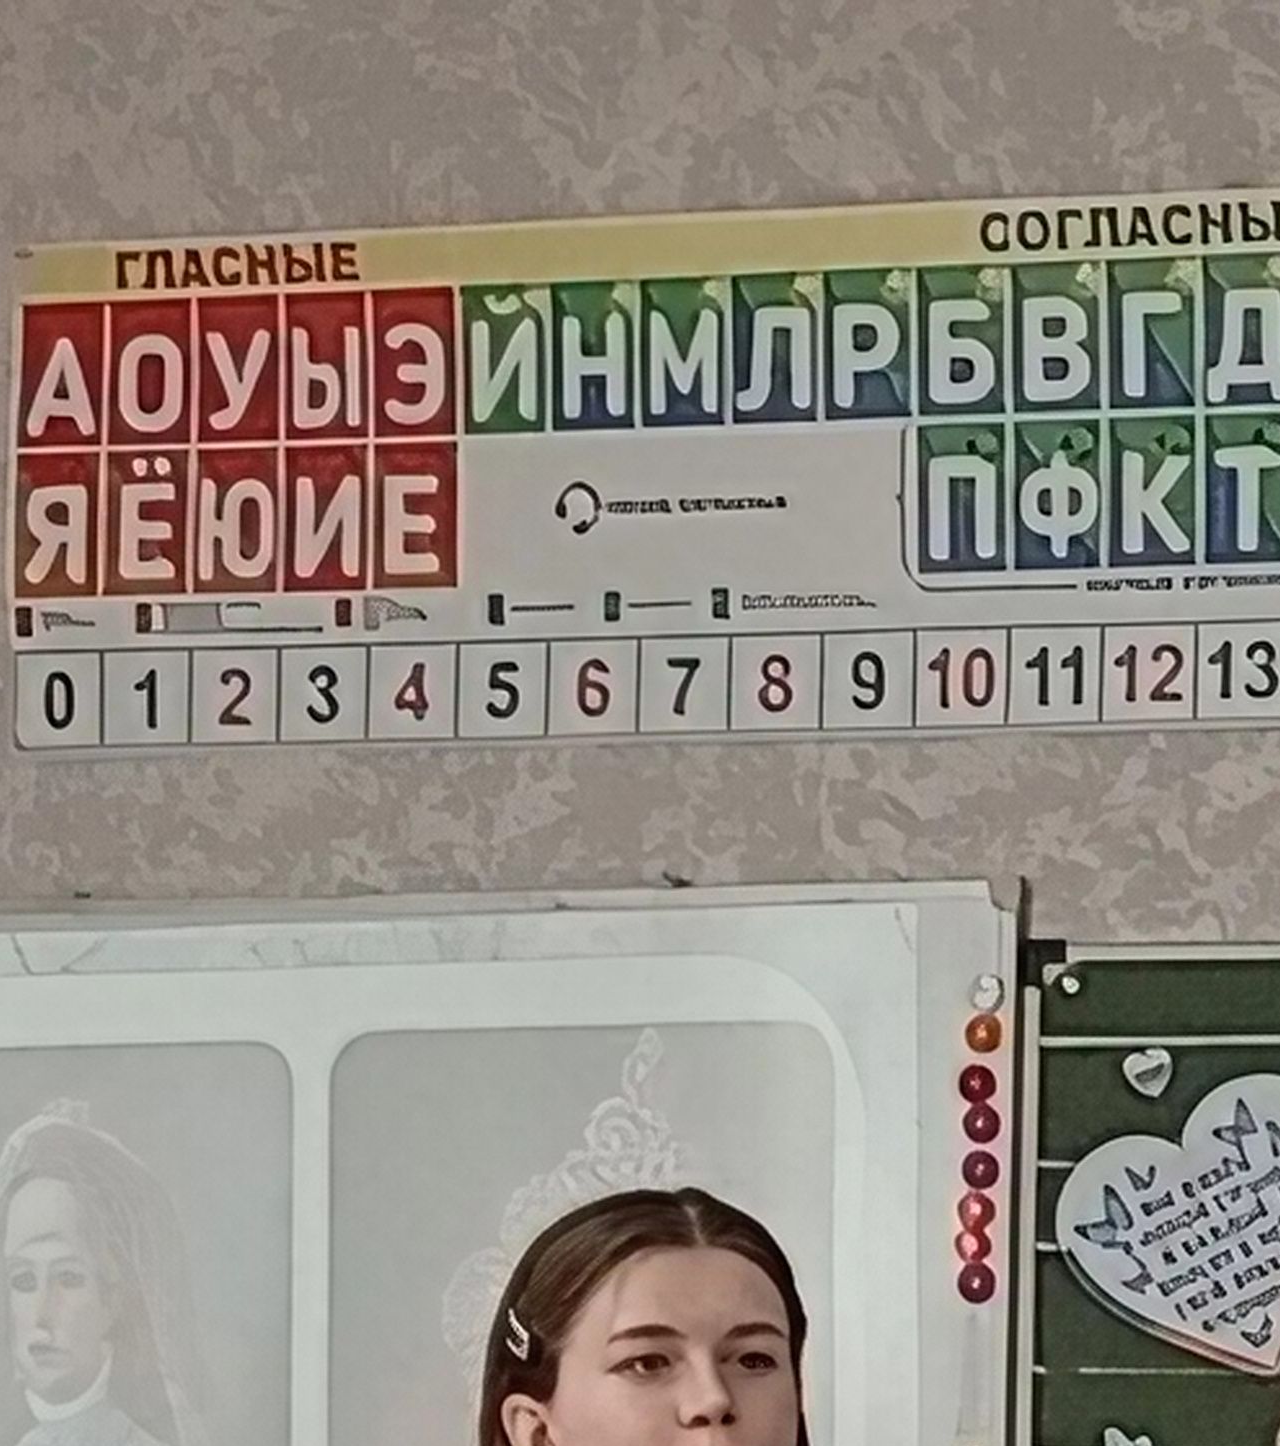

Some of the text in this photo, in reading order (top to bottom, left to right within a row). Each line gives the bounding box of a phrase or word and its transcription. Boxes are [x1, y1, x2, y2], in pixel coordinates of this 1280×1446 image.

[116, 242, 360, 289] ГЛАСНЫЕ
[44, 671, 75, 729] 0
[134, 668, 159, 728] 1
[219, 668, 251, 725] 2
[307, 664, 339, 723] 3
[395, 662, 429, 721] 4
[487, 661, 520, 719] 5
[577, 658, 611, 716] 6
[667, 658, 701, 716] 7
[758, 654, 794, 713] 8
[852, 651, 885, 710] 9
[928, 646, 995, 709] 10
[1026, 645, 1084, 706] 11
[1115, 643, 1182, 703] 12
[1208, 640, 1280, 700] 13
